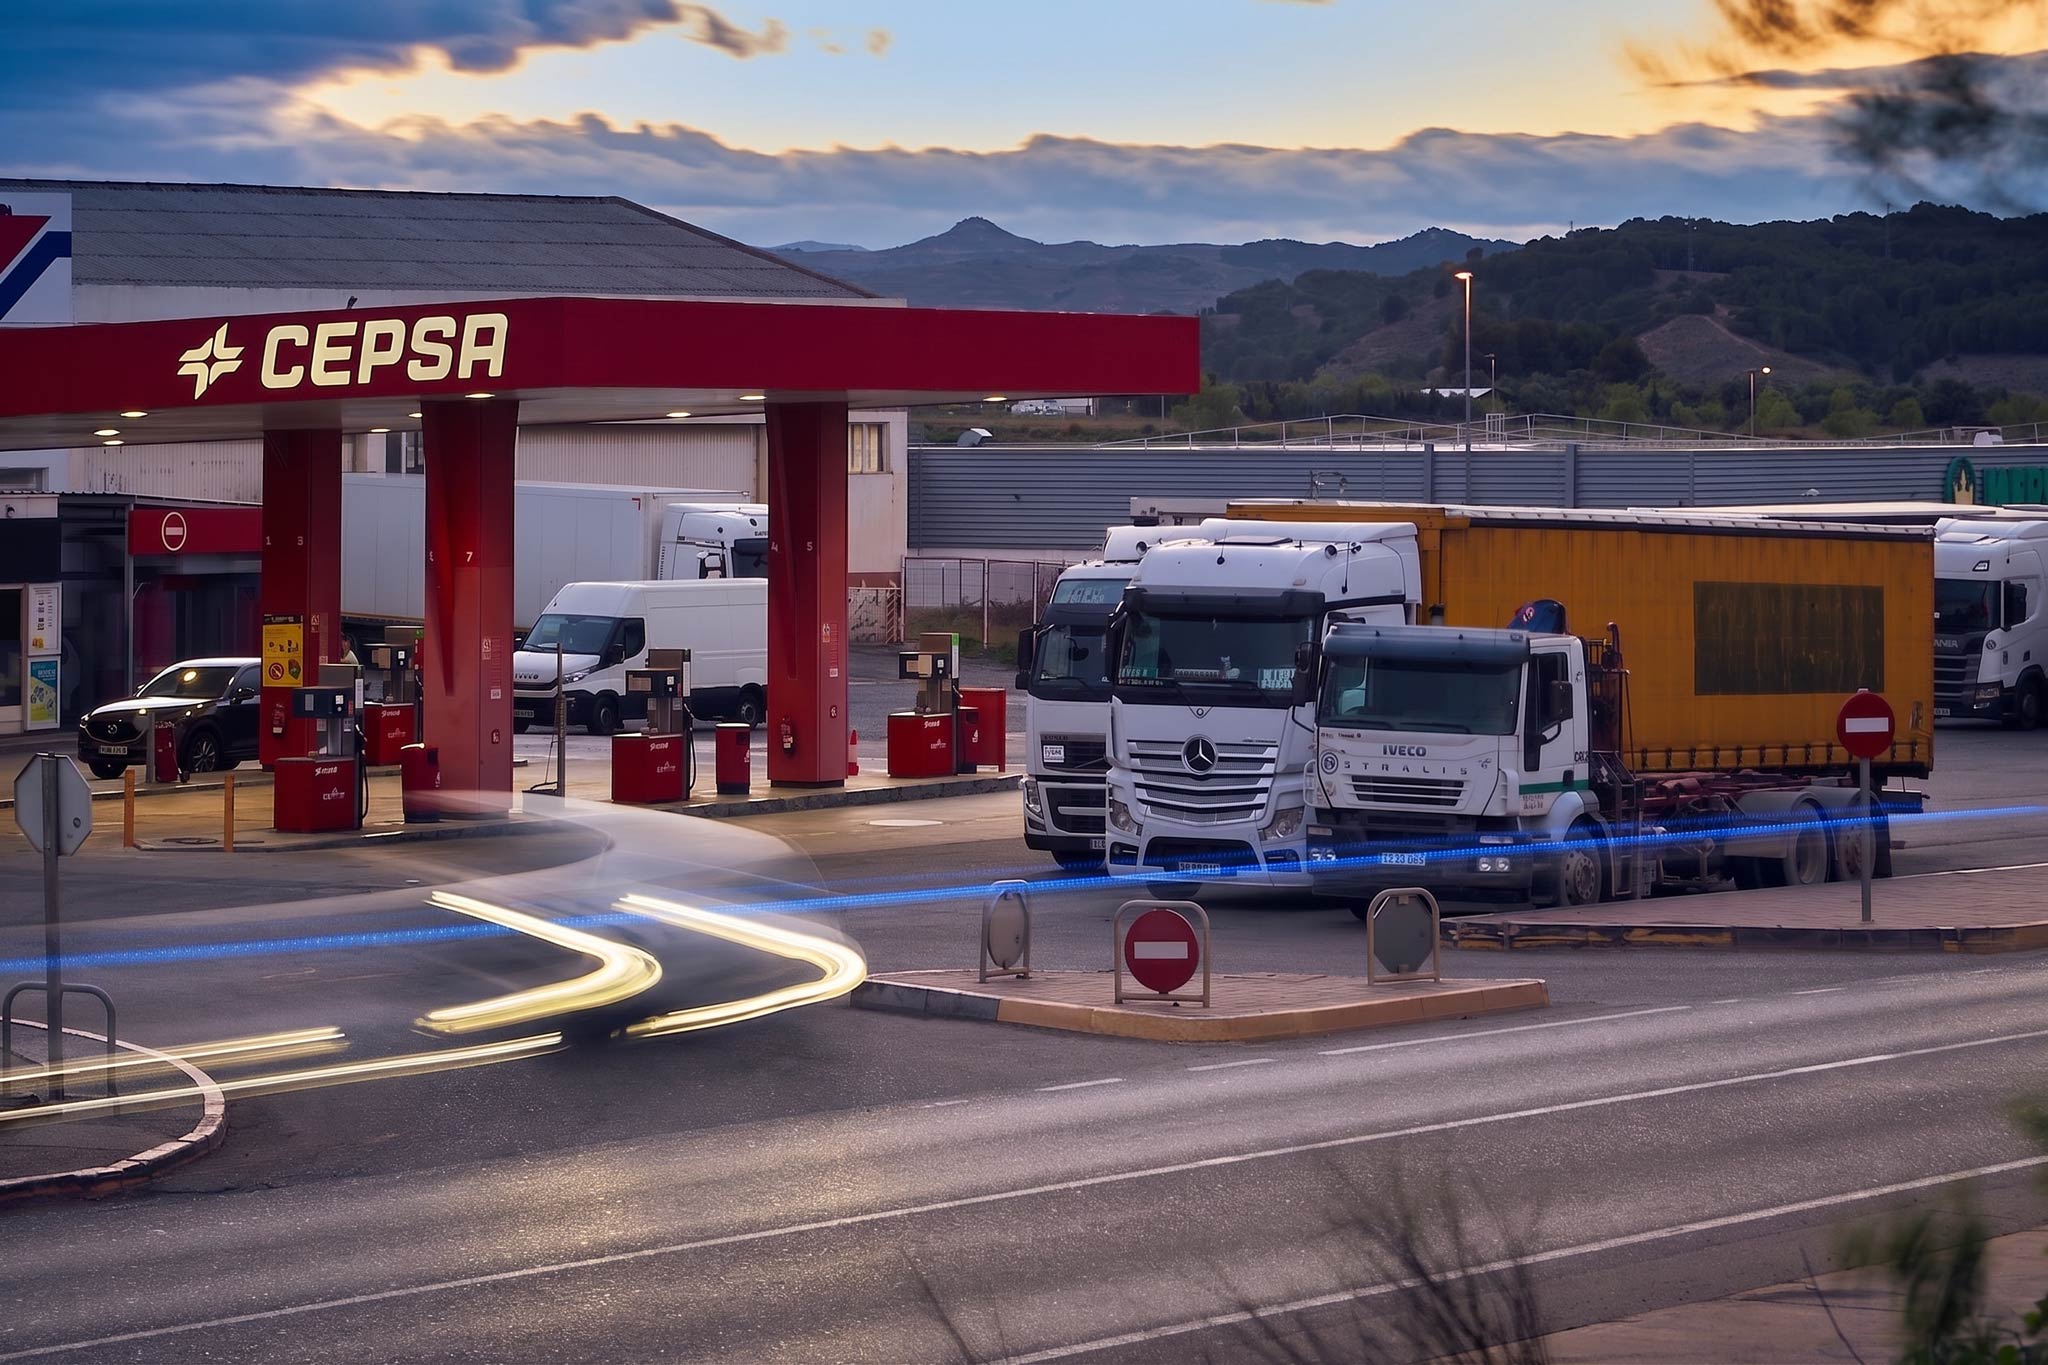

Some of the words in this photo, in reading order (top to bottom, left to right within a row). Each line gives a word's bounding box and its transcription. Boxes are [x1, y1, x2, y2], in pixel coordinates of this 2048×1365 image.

[260, 313, 508, 390] CEPSA
[265, 536, 272, 546] 1
[297, 536, 304, 546] 3
[806, 541, 813, 551] 5
[466, 551, 473, 562] 7
[1933, 639, 1959, 648] ANIA
[1382, 744, 1427, 757] IVECO
[1344, 761, 1467, 775] STRALIS
[1383, 853, 1405, 863] 1223
